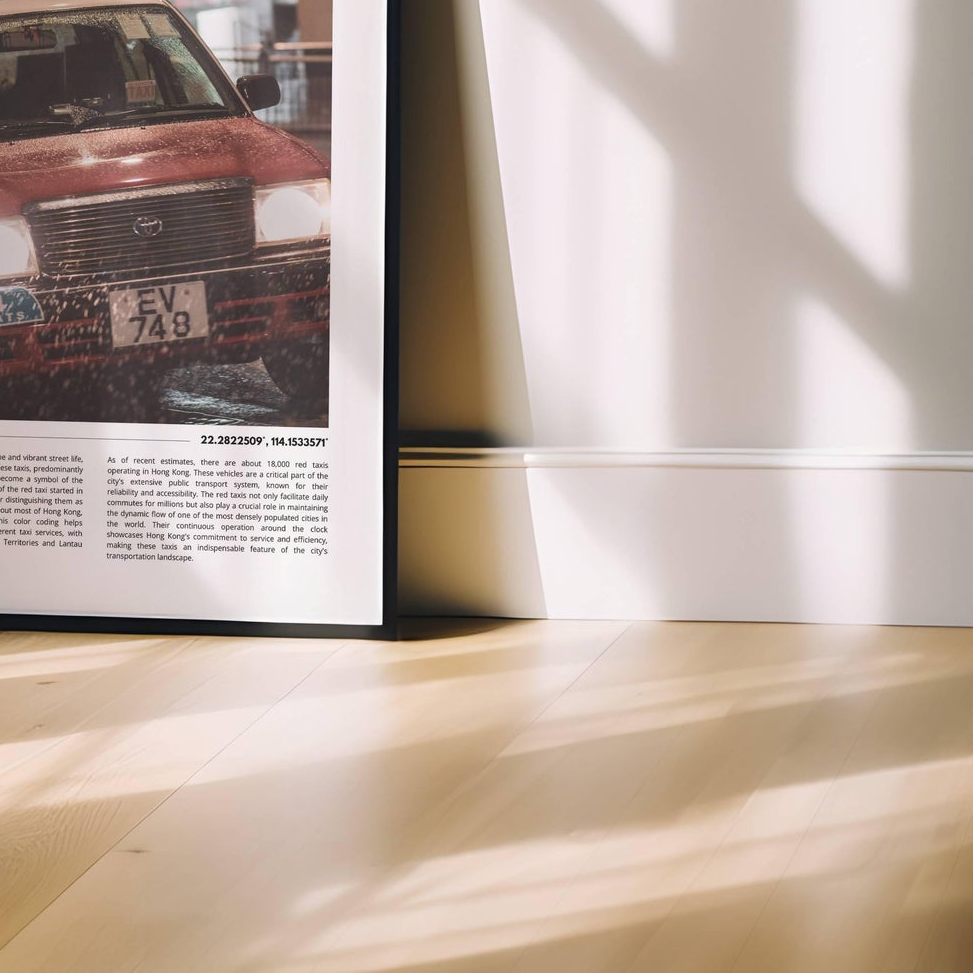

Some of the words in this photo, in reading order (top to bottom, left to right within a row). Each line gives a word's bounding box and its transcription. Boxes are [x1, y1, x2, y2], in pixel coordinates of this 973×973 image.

[138, 286, 176, 315] EV
[129, 311, 190, 343] 748
[7, 453, 21, 461] and
[22, 453, 47, 462] vibrant
[70, 454, 83, 464] life,
[107, 455, 116, 463] As
[120, 456, 128, 464] of
[160, 456, 195, 466] estimates,
[200, 457, 219, 466] there
[241, 458, 261, 467] about
[267, 459, 290, 469] 18,000
[295, 459, 307, 468] red
[312, 460, 328, 468] taxis
[13, 463, 31, 473] taxis,
[33, 464, 83, 475] predominantly
[33, 474, 58, 485] symbol
[61, 475, 69, 483] of
[71, 475, 83, 483] the
[130, 477, 162, 486] extensive
[168, 478, 189, 488] public
[195, 479, 227, 489] transport
[233, 480, 259, 490] system,
[266, 480, 289, 489] known
[295, 481, 306, 489] for
[311, 481, 328, 489] their
[5, 495, 52, 506] distinguishing
[54, 496, 72, 504] them
[107, 487, 138, 498] reliability
[140, 488, 153, 496] and
[155, 488, 198, 499] accessibility.
[200, 489, 214, 498] The
[215, 490, 228, 498] red
[230, 490, 246, 498] taxis
[248, 491, 260, 499] not
[262, 491, 278, 501] only
[280, 491, 309, 500] facilitate
[311, 492, 328, 502] daily
[33, 506, 41, 514] of
[42, 506, 61, 517] Hong
[63, 507, 82, 517] Kong,
[106, 499, 143, 507] commutes
[145, 499, 155, 507] for
[157, 499, 183, 507] millions
[185, 500, 197, 508] but
[199, 500, 213, 508] also
[215, 500, 230, 511] play
[238, 501, 260, 509] crucial
[262, 501, 276, 510] role
[278, 502, 285, 510] in
[287, 502, 328, 513] maintaining
[13, 516, 31, 525] color
[35, 517, 59, 527] coding
[63, 517, 82, 528] helps
[19, 527, 32, 535] taxi
[35, 527, 64, 537] services,
[67, 528, 82, 536] with
[106, 530, 143, 538] showcases
[146, 531, 164, 541] Hong
[192, 532, 237, 541] commitment
[250, 533, 274, 542] service
[276, 534, 290, 542] and
[293, 534, 327, 545] efficiency,
[3, 537, 39, 546] Territories
[41, 538, 55, 546] and
[58, 539, 82, 547] Lantau
[106, 540, 131, 551] making
[136, 541, 156, 549] these
[161, 542, 177, 550] taxis
[197, 542, 244, 554] indispensable
[250, 544, 275, 552] feature
[280, 544, 288, 553] of
[293, 545, 305, 553] the
[106, 551, 155, 562] transportation
[157, 552, 193, 563] landscape.
